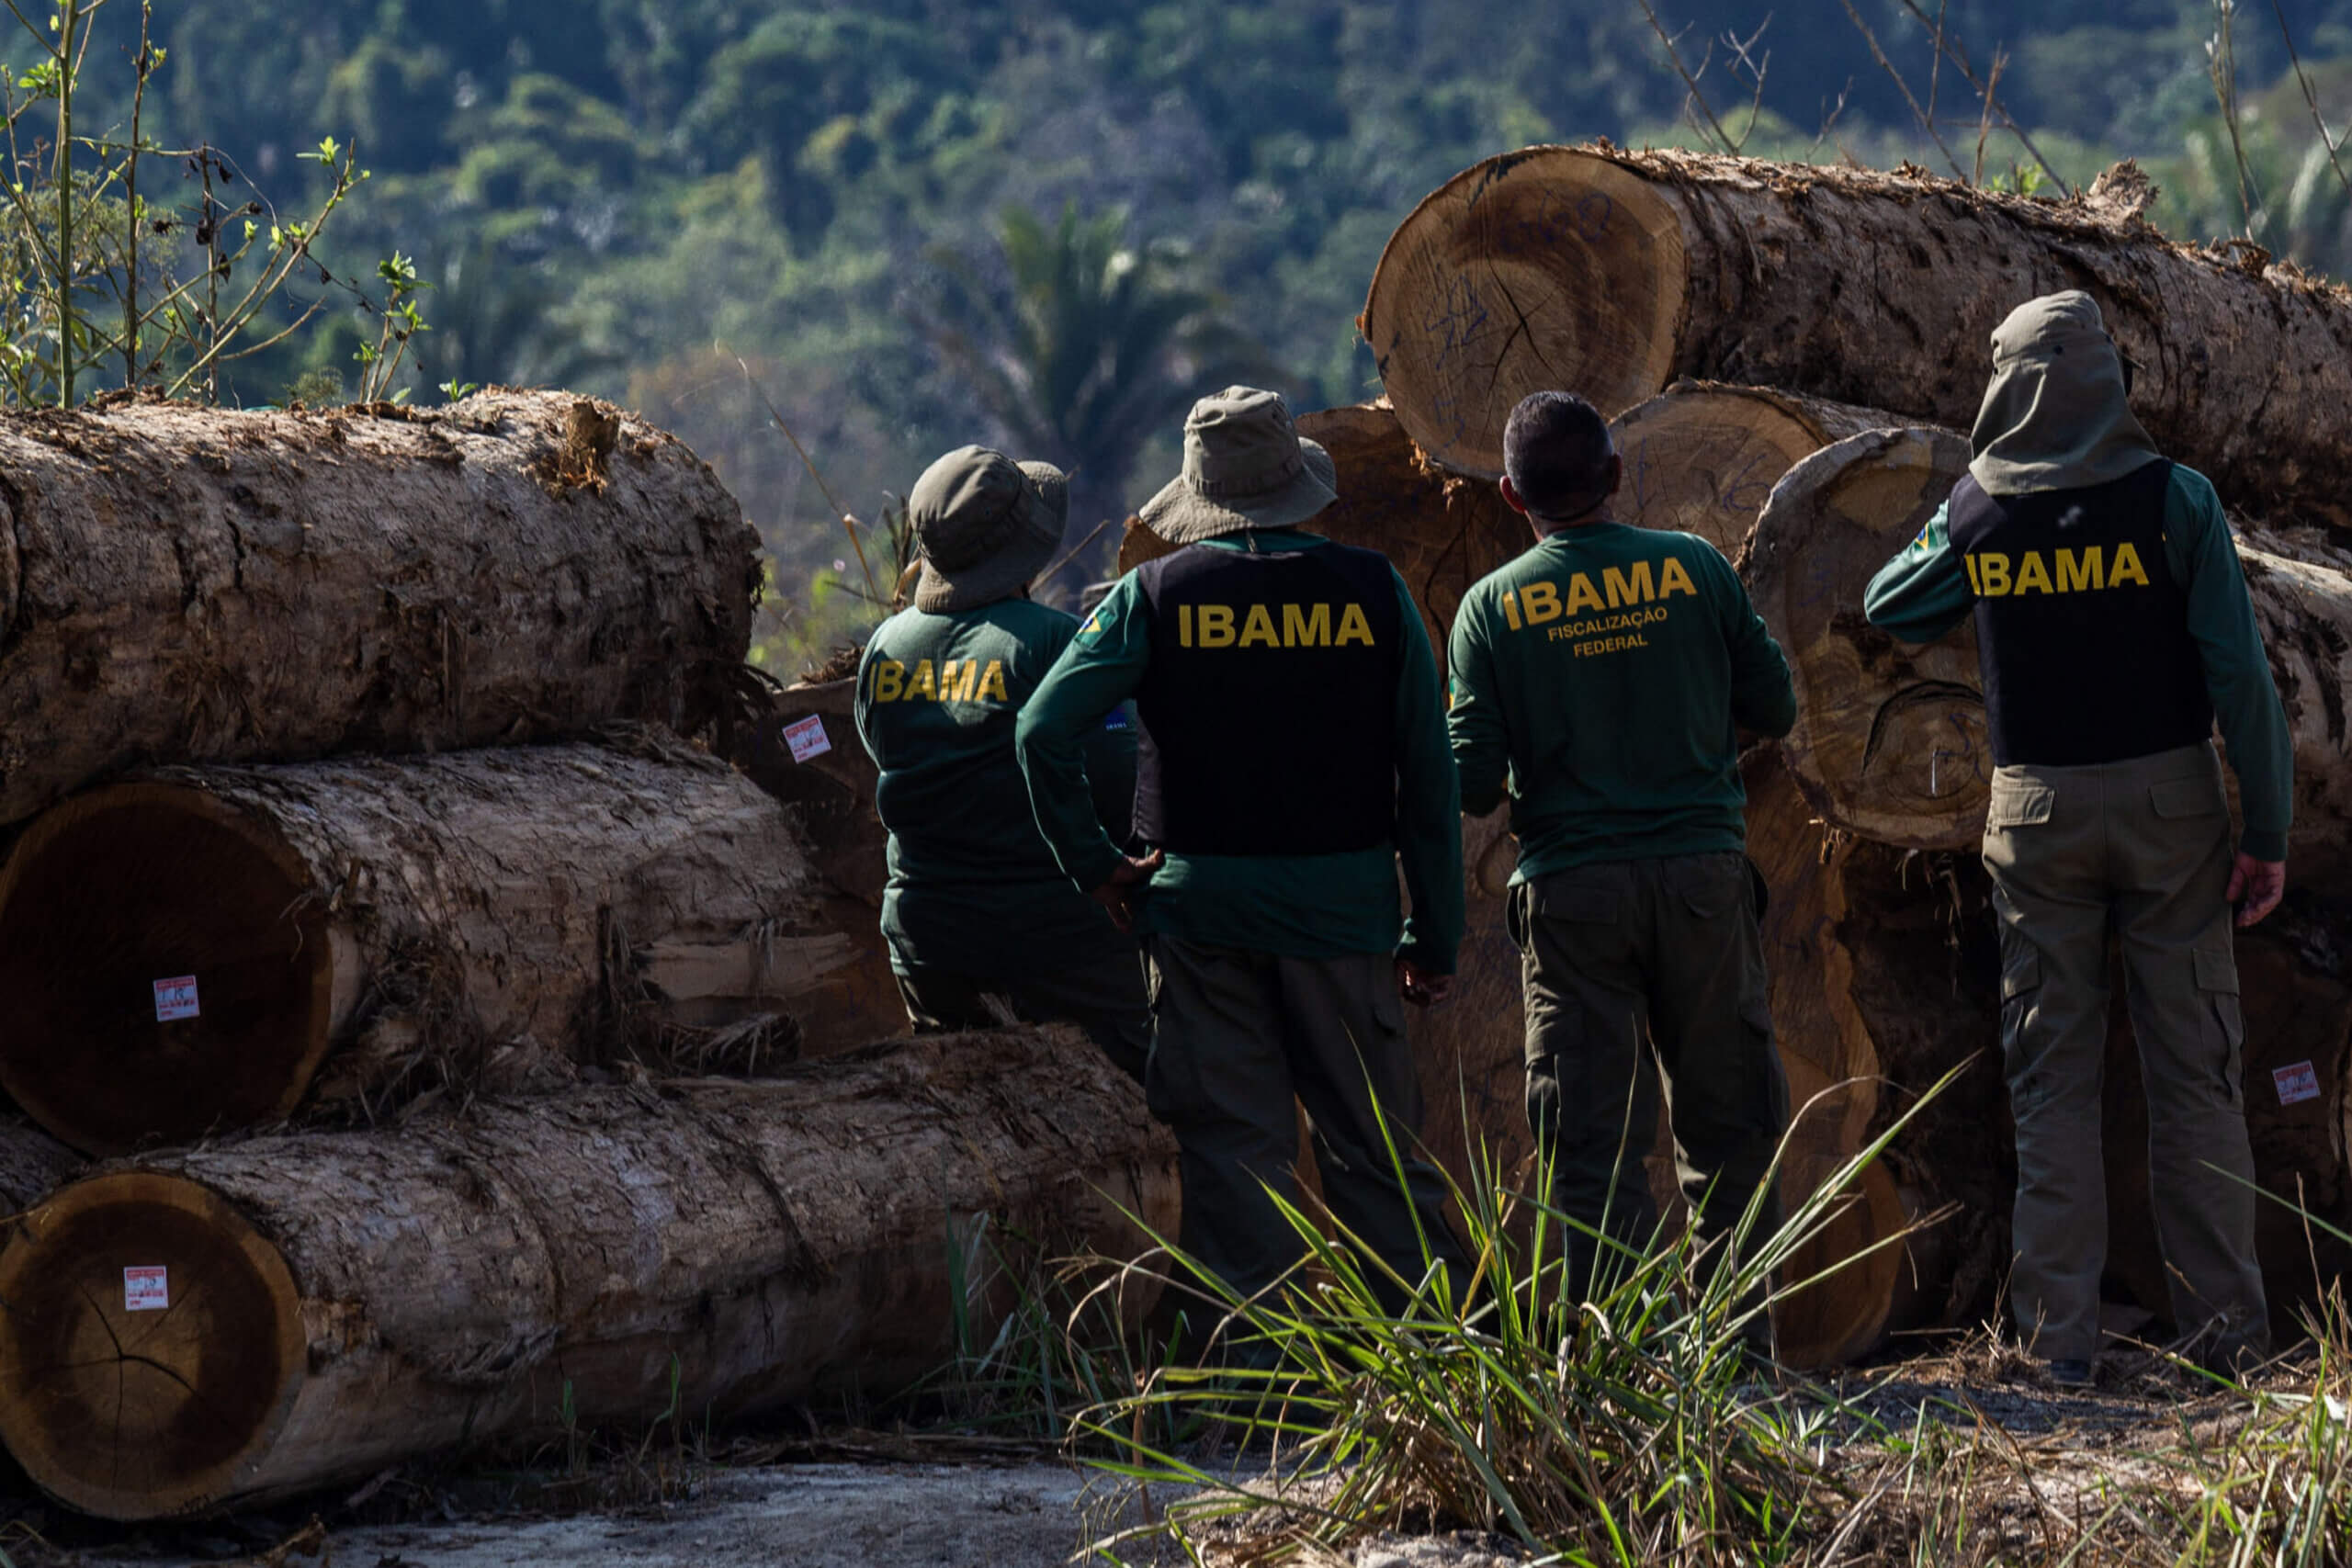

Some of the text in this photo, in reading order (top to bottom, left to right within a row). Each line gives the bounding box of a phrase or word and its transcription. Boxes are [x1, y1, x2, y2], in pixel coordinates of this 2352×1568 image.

[1963, 542, 2150, 596] IBAMA
[1501, 557, 1698, 631] IBAMA
[1179, 603, 1375, 648] IBAMA
[1547, 605, 1668, 642] FISCALIZAÇÃO
[1573, 633, 1649, 658] FEDERAL
